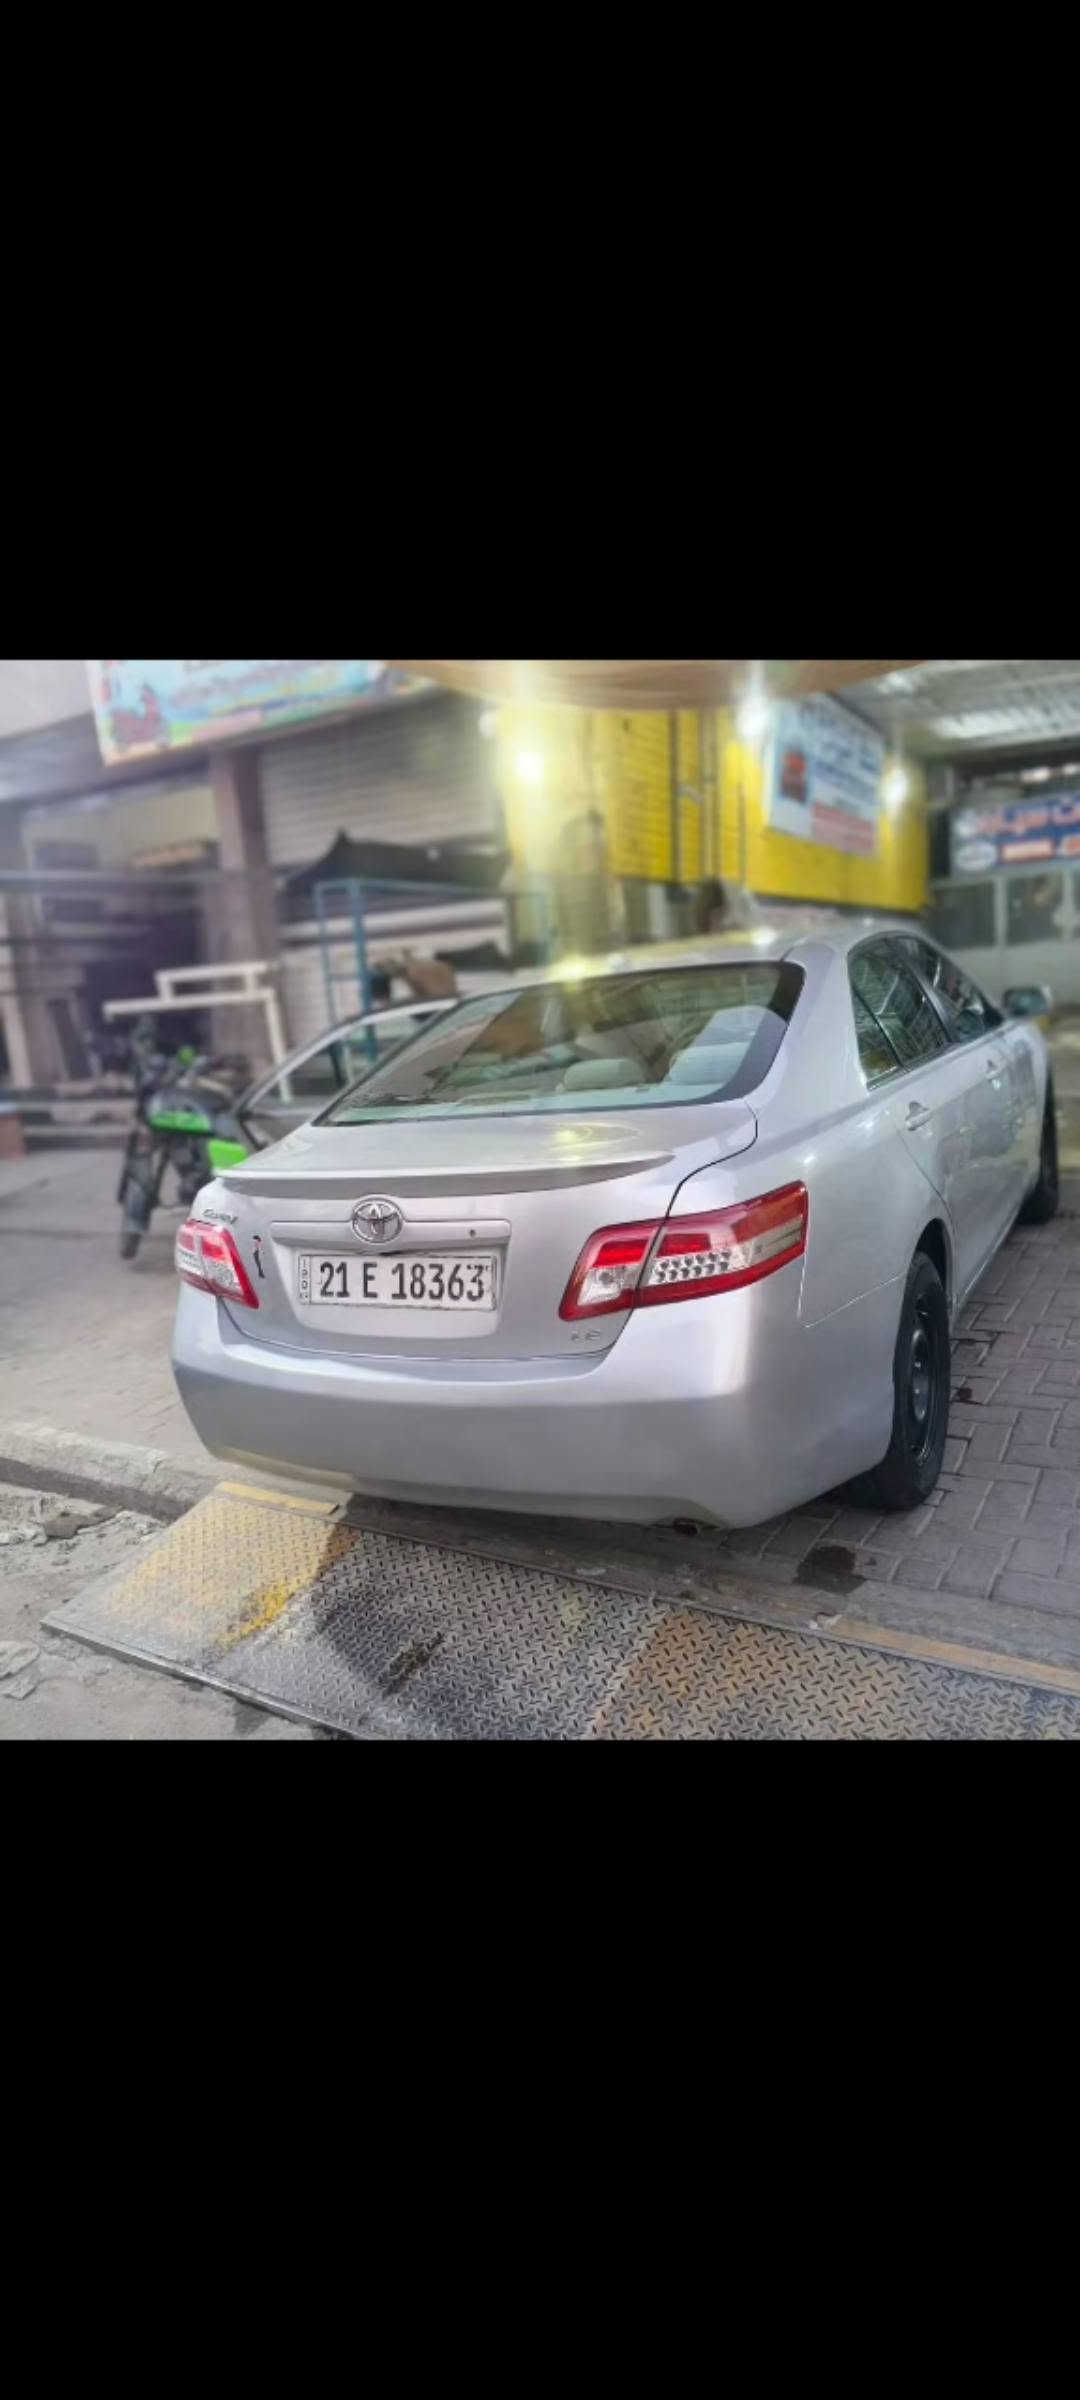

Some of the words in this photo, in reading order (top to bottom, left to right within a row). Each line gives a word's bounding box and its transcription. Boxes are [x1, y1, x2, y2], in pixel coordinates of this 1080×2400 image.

[320, 1261, 350, 1298] 21
[363, 1261, 379, 1298] E
[391, 1262, 485, 1302] 18363
